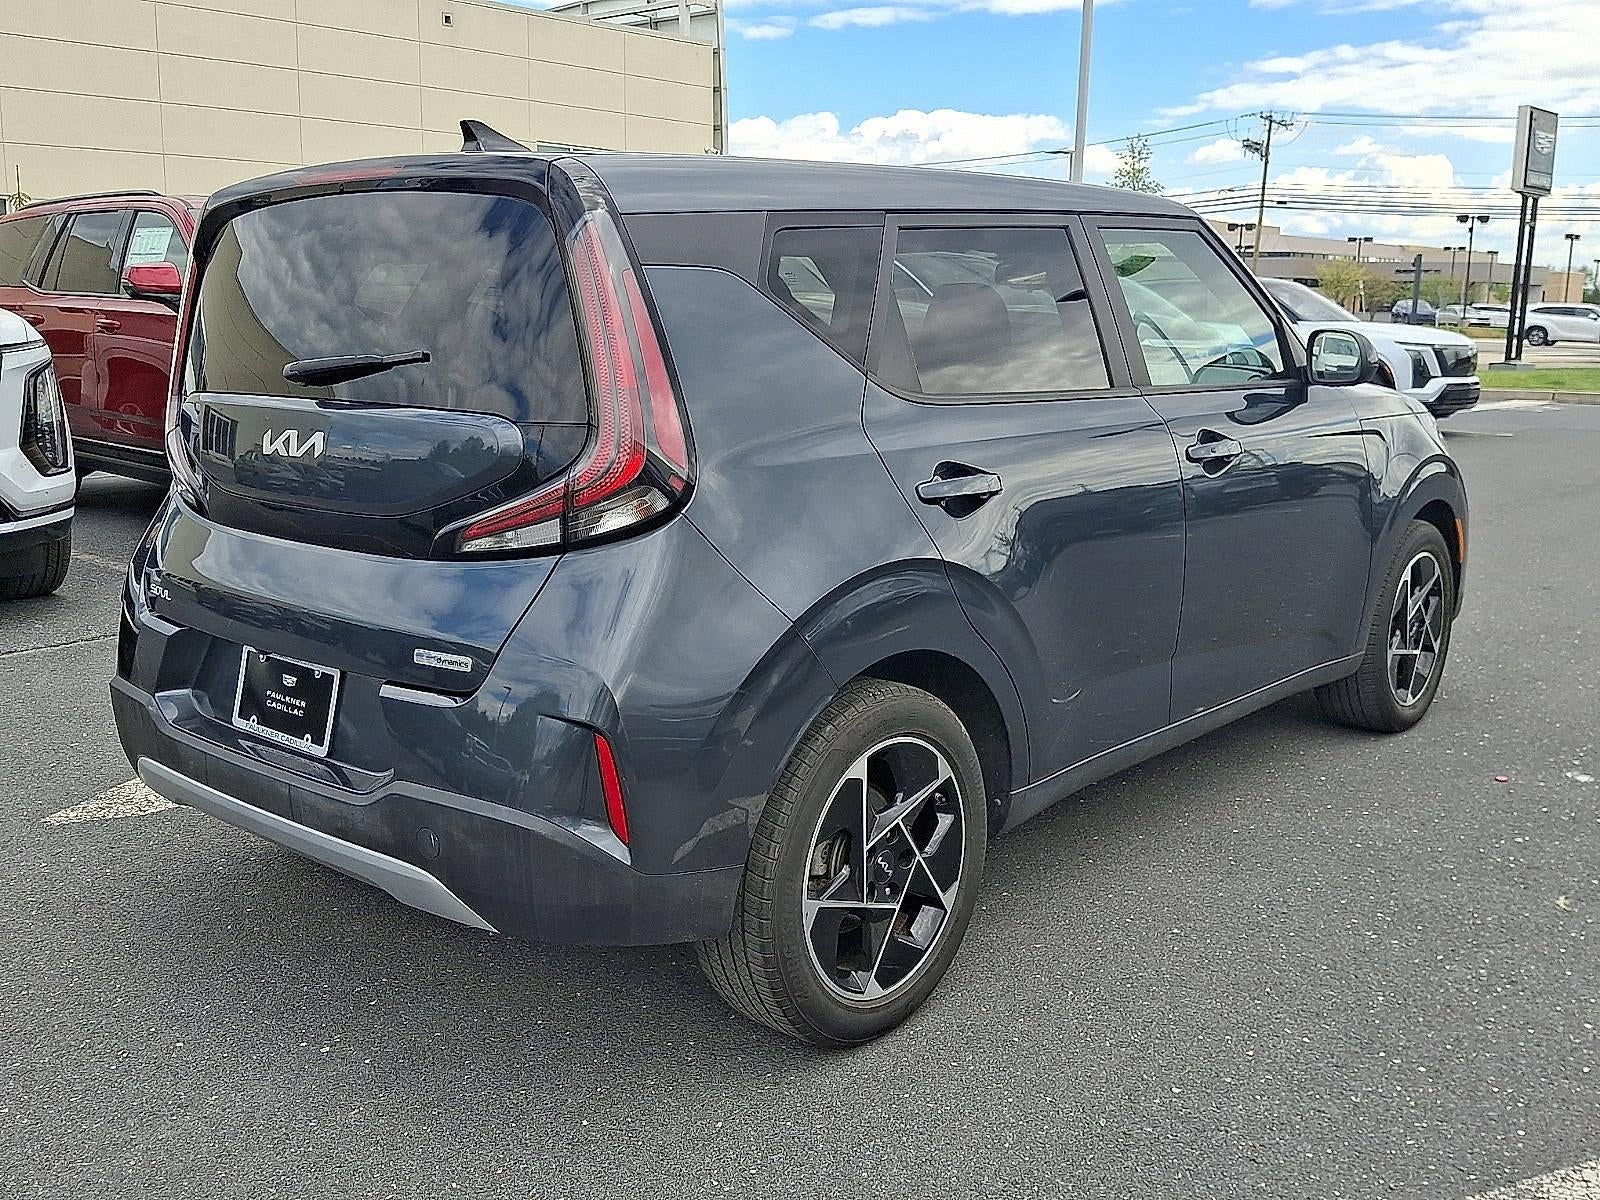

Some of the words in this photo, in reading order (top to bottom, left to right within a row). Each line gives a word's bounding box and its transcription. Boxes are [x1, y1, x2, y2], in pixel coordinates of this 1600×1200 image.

[262, 428, 325, 459] KIA
[149, 583, 172, 601] SOUL
[437, 656, 469, 669] dynamics
[266, 690, 306, 709] FAULKNER
[266, 700, 304, 717] CADILLAC
[245, 722, 281, 739] FAULKNER
[280, 735, 314, 751] CADILLAC
